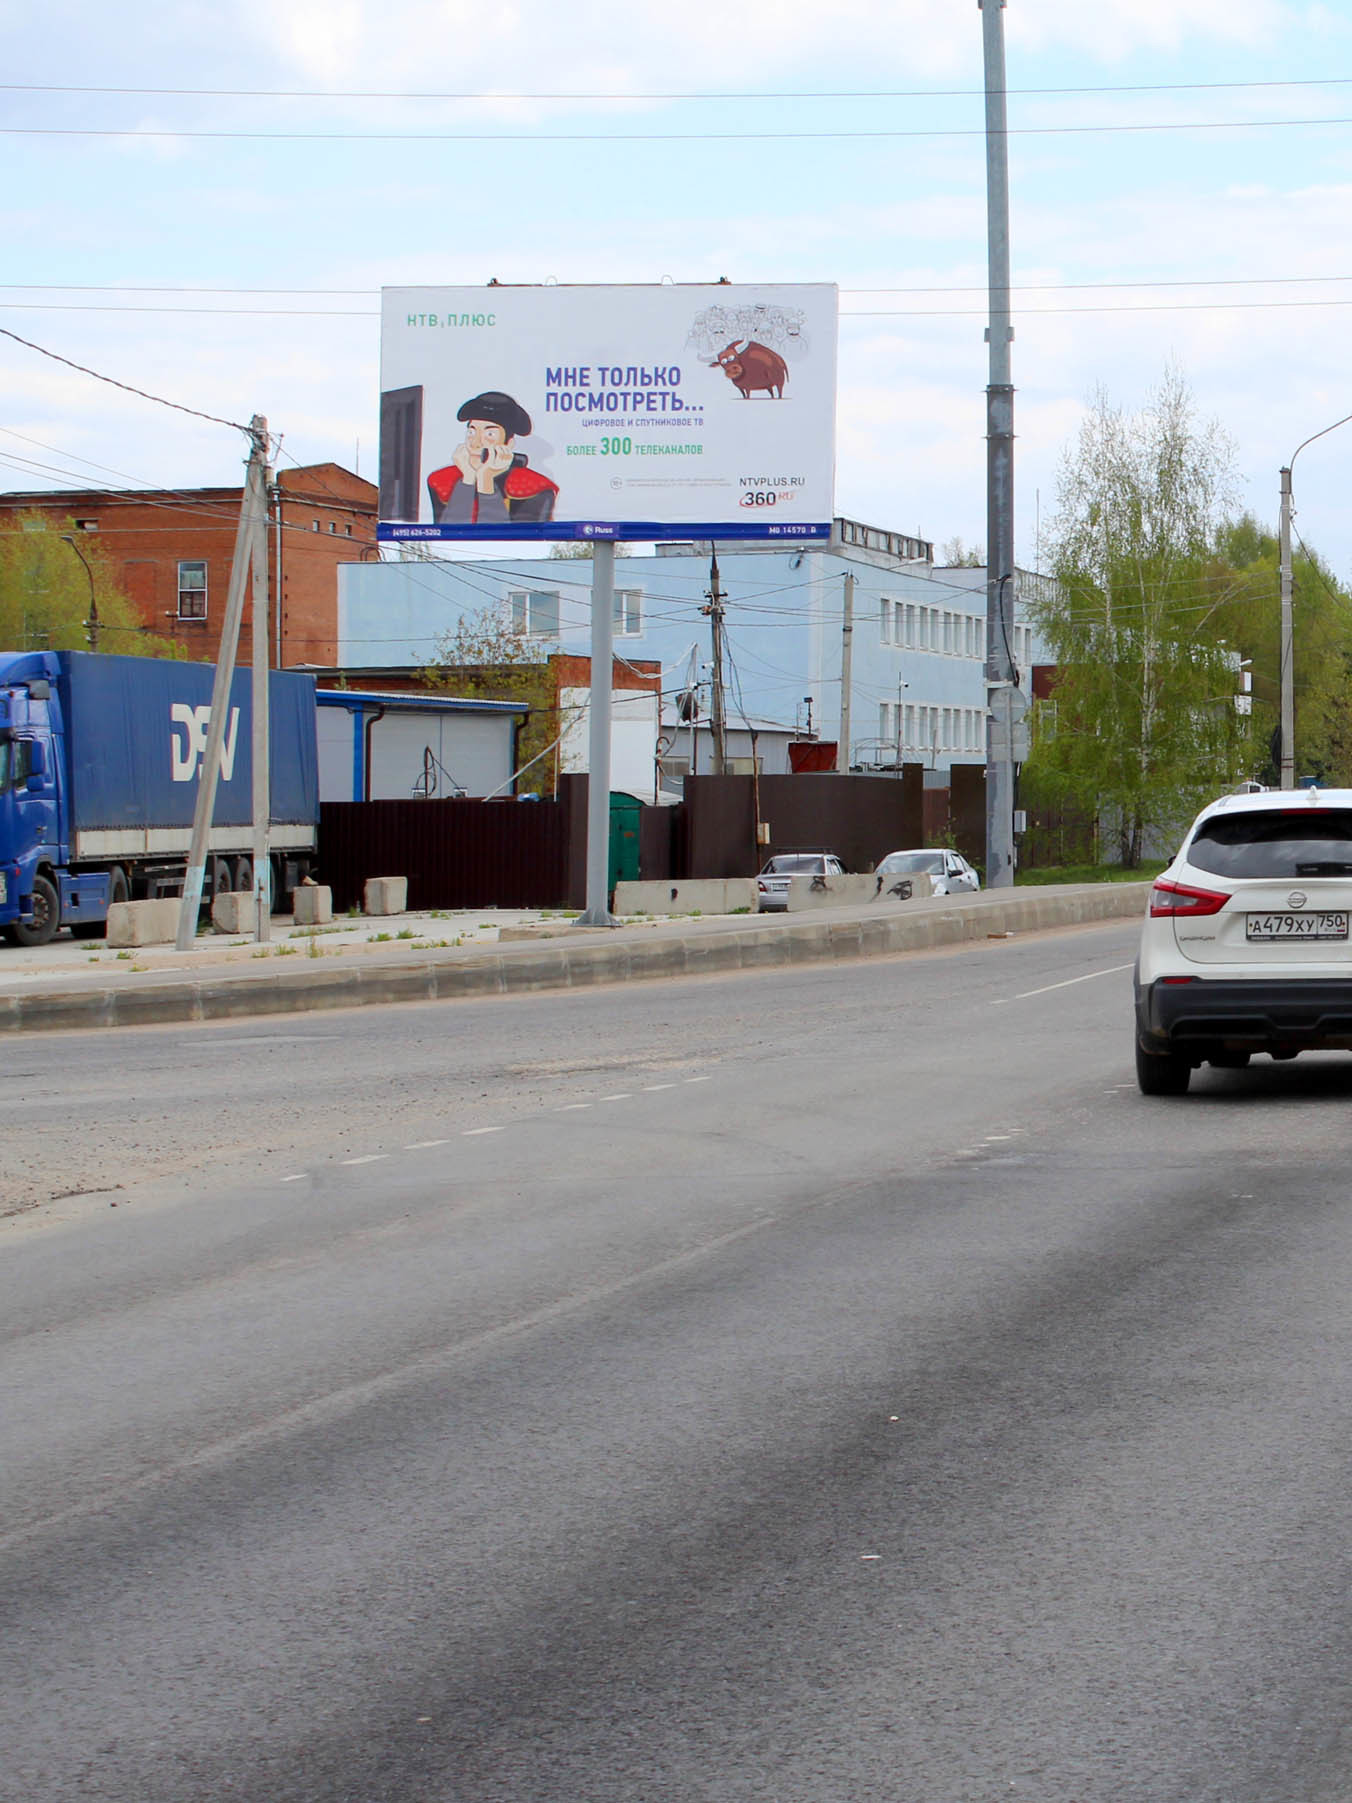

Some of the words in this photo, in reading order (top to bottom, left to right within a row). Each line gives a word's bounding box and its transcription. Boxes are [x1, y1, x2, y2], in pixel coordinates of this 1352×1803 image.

[546, 367, 591, 387] МНЕ
[598, 366, 681, 387] ТОЛЬКО
[546, 391, 704, 412] ПОСМОТРЕТЬ...
[582, 418, 625, 427] ЦИФРОВОЕ
[627, 418, 633, 427] И
[635, 418, 692, 427] СПУТНИКОВОЕ
[694, 418, 704, 427] ТВ
[566, 445, 596, 455] БОЛЕЕ
[600, 437, 632, 455] 300
[635, 444, 703, 455] ТЕЛЕКАНАЛОВ
[739, 477, 805, 487] NTVPLUS.RU
[744, 491, 776, 506] 360
[594, 526, 613, 534] Russ
[1319, 914, 1343, 928] 750
